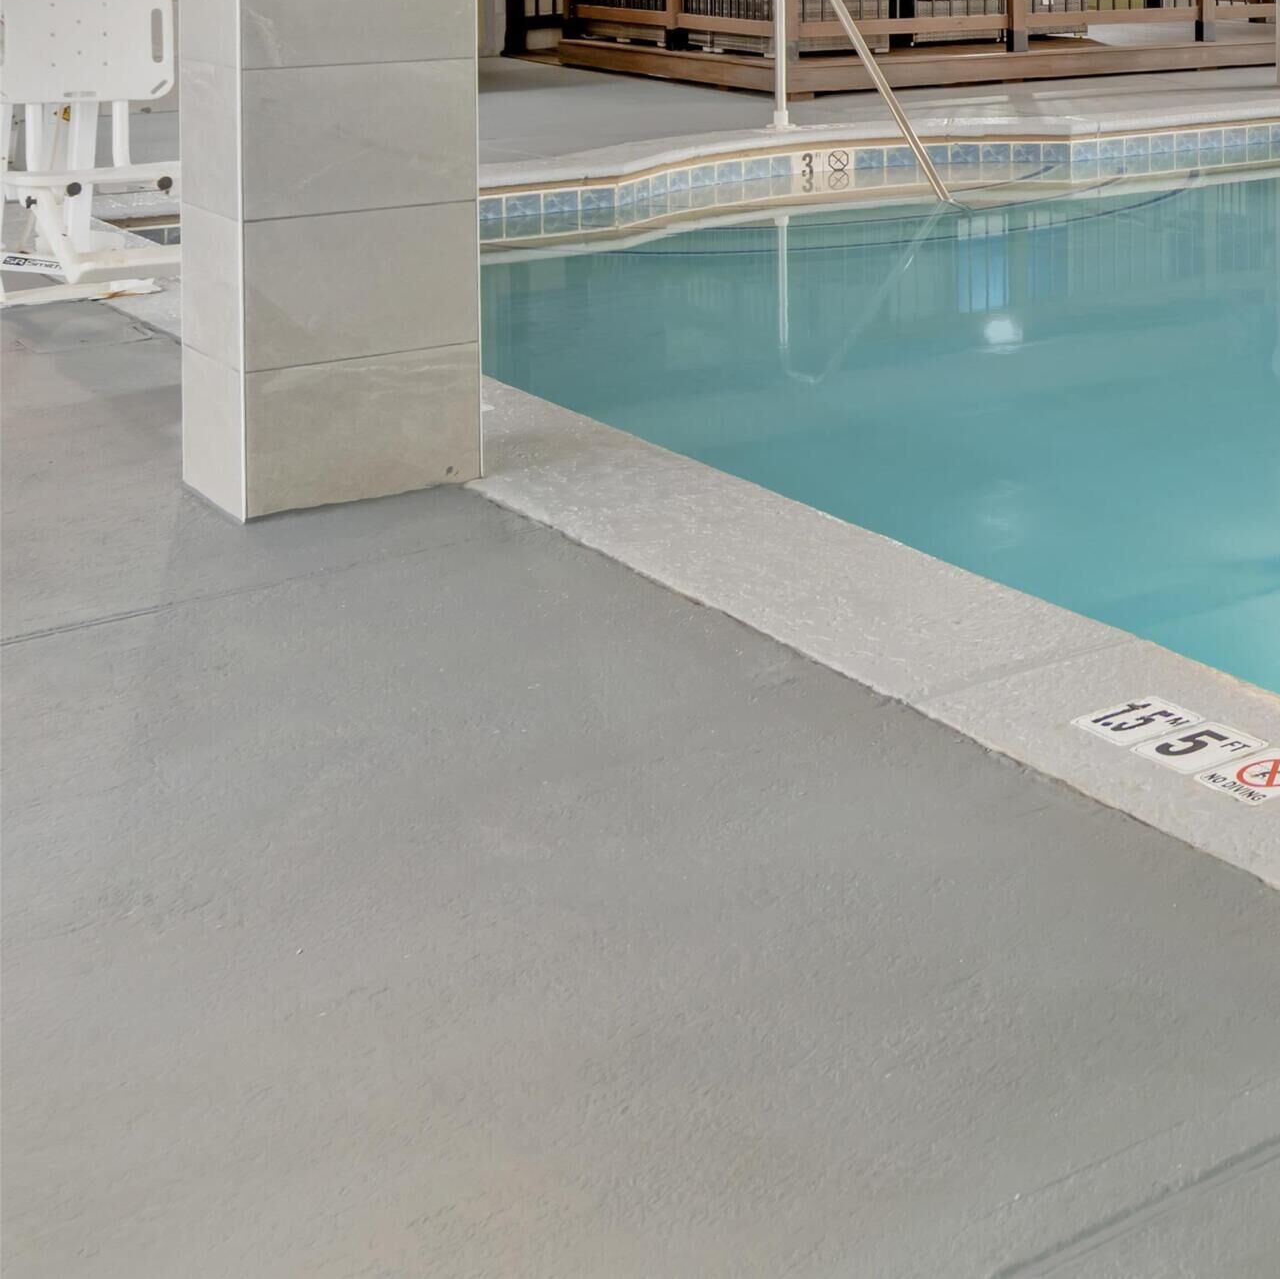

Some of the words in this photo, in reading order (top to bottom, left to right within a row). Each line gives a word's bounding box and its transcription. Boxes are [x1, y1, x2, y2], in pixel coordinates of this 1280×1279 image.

[802, 153, 814, 175] 3
[1155, 730, 1229, 756] 5
[1220, 740, 1252, 752] FT
[1204, 773, 1227, 783] NO
[1221, 781, 1267, 801] DIVING
